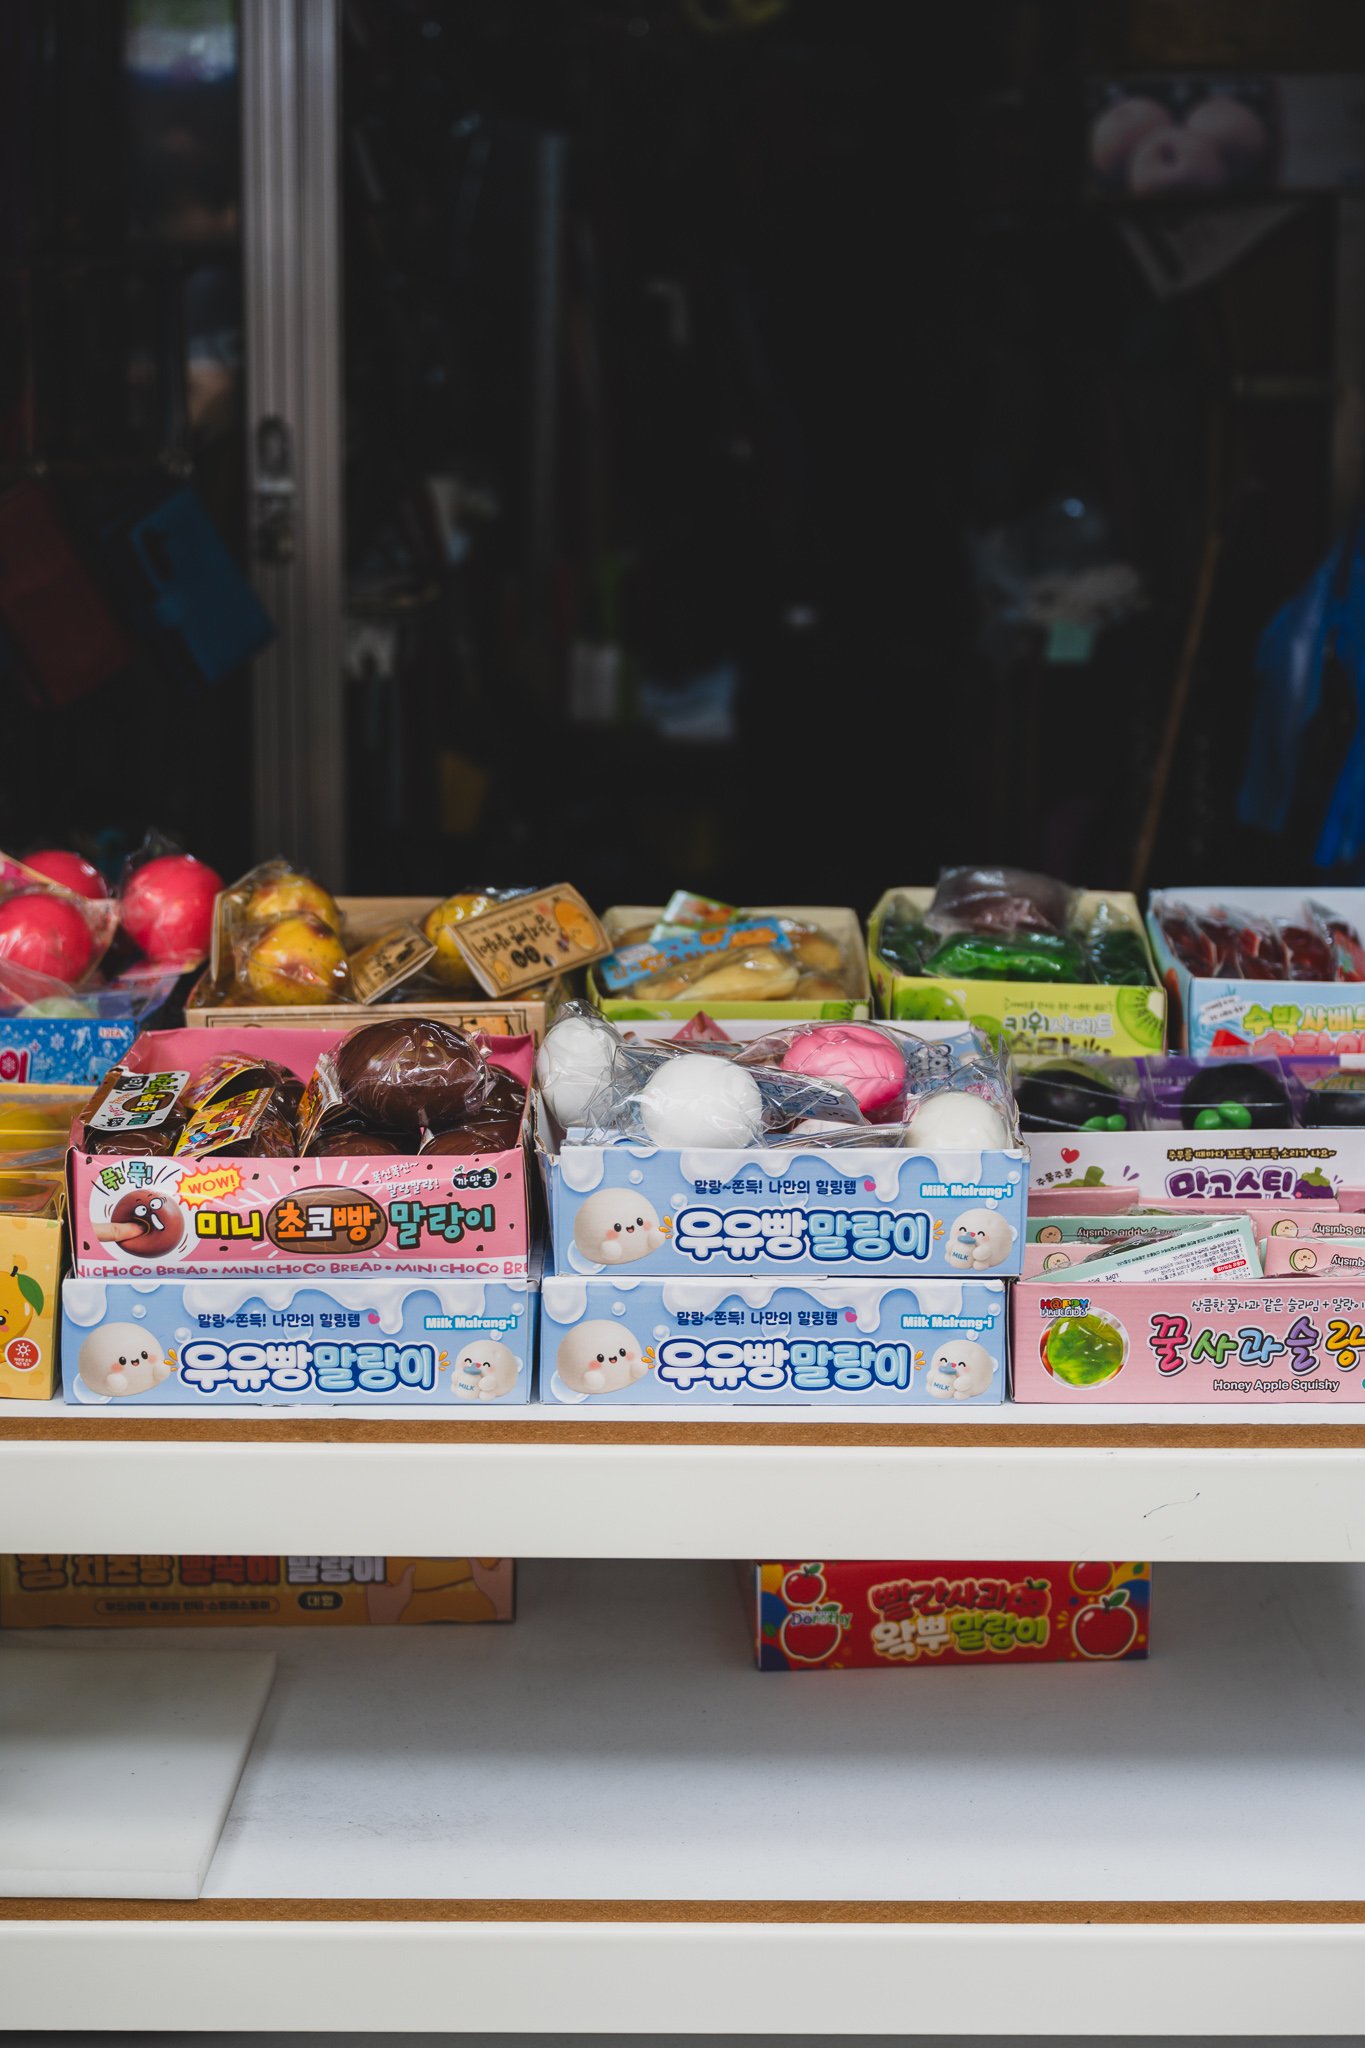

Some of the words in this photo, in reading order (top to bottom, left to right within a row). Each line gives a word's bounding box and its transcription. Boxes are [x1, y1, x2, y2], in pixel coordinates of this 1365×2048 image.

[1280, 1147, 1309, 1160] 소리가
[188, 1175, 237, 1194] WOW!
[456, 1173, 493, 1187] 까망콩
[694, 1179, 763, 1195] 말랑~쫀득!
[769, 1179, 811, 1195] 나만의
[815, 1179, 857, 1195] 힐링템
[386, 1179, 440, 1198] 말랑말랑!
[921, 1184, 948, 1198] Milk
[950, 1184, 1013, 1198] Malrang-i
[195, 1210, 264, 1242] 미니
[275, 1199, 381, 1247] 초코빵
[389, 1201, 496, 1249] 말랑이
[1313, 1223, 1352, 1236] Squishy
[952, 1252, 969, 1260] MILK
[1192, 1298, 1224, 1312] 상큼한
[1227, 1298, 1260, 1312] 꿀사과
[1262, 1298, 1283, 1312] 같은
[1288, 1298, 1319, 1312] 슬라임
[198, 1313, 267, 1328] 말랑~쫀득!
[273, 1313, 315, 1328] 나만의
[319, 1312, 361, 1328] 힐링템
[425, 1316, 452, 1330] Milk
[455, 1316, 517, 1330] Malrang-i
[677, 1311, 745, 1326] 말랑~쫀득!
[751, 1311, 792, 1326] 나만의
[797, 1311, 838, 1326] 힐링템
[902, 1315, 929, 1329] Milk
[931, 1315, 994, 1330] Malrang-i
[458, 1383, 476, 1391] MILK
[933, 1381, 950, 1391] MILK
[1213, 1380, 1251, 1392] Honey
[1254, 1380, 1289, 1392] Apple
[1291, 1379, 1340, 1392] Squishy
[790, 1613, 852, 1629] Dorothy
[952, 1612, 1048, 1651] 말랑이
